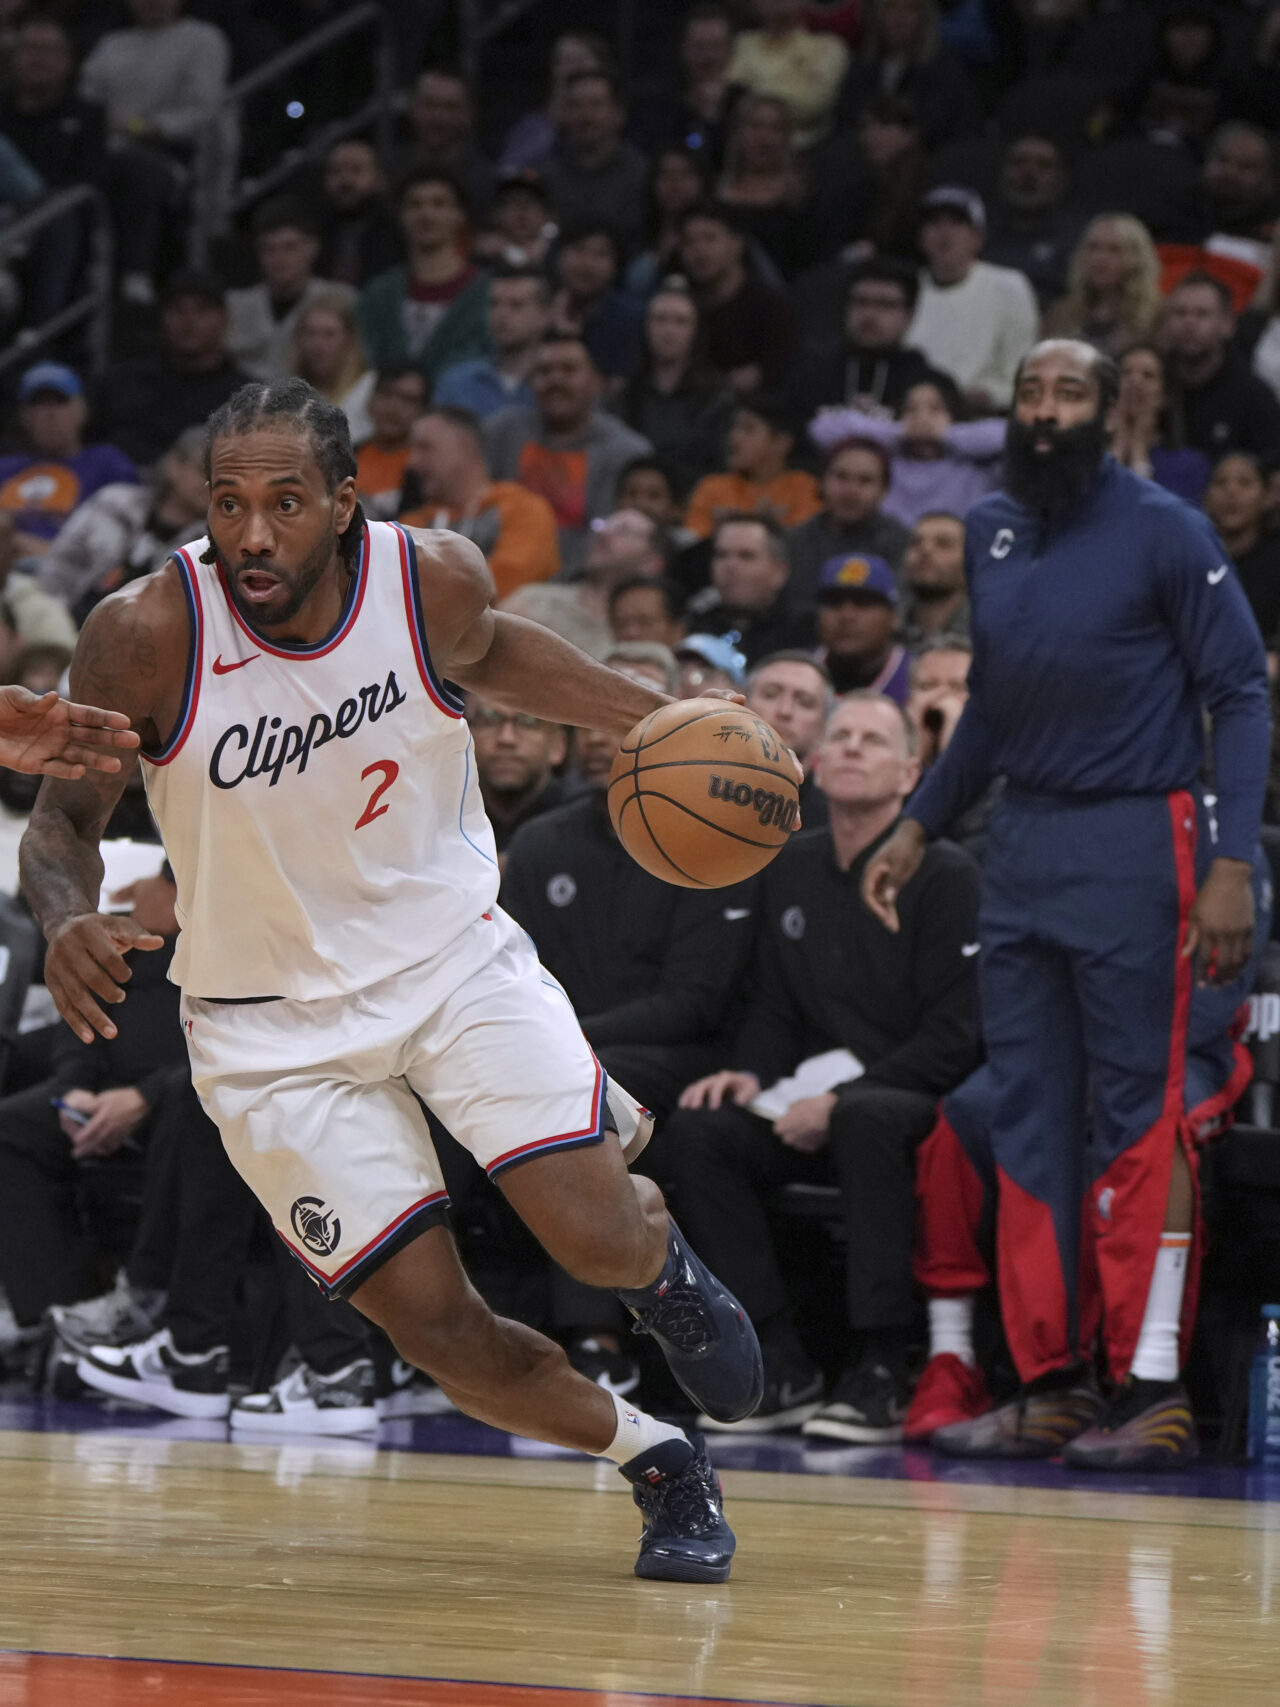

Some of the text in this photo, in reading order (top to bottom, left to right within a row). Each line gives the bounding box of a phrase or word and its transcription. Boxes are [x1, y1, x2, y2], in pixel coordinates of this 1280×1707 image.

[208, 669, 408, 790] Clippers
[354, 759, 400, 831] 2
[708, 773, 798, 834] Wilson
